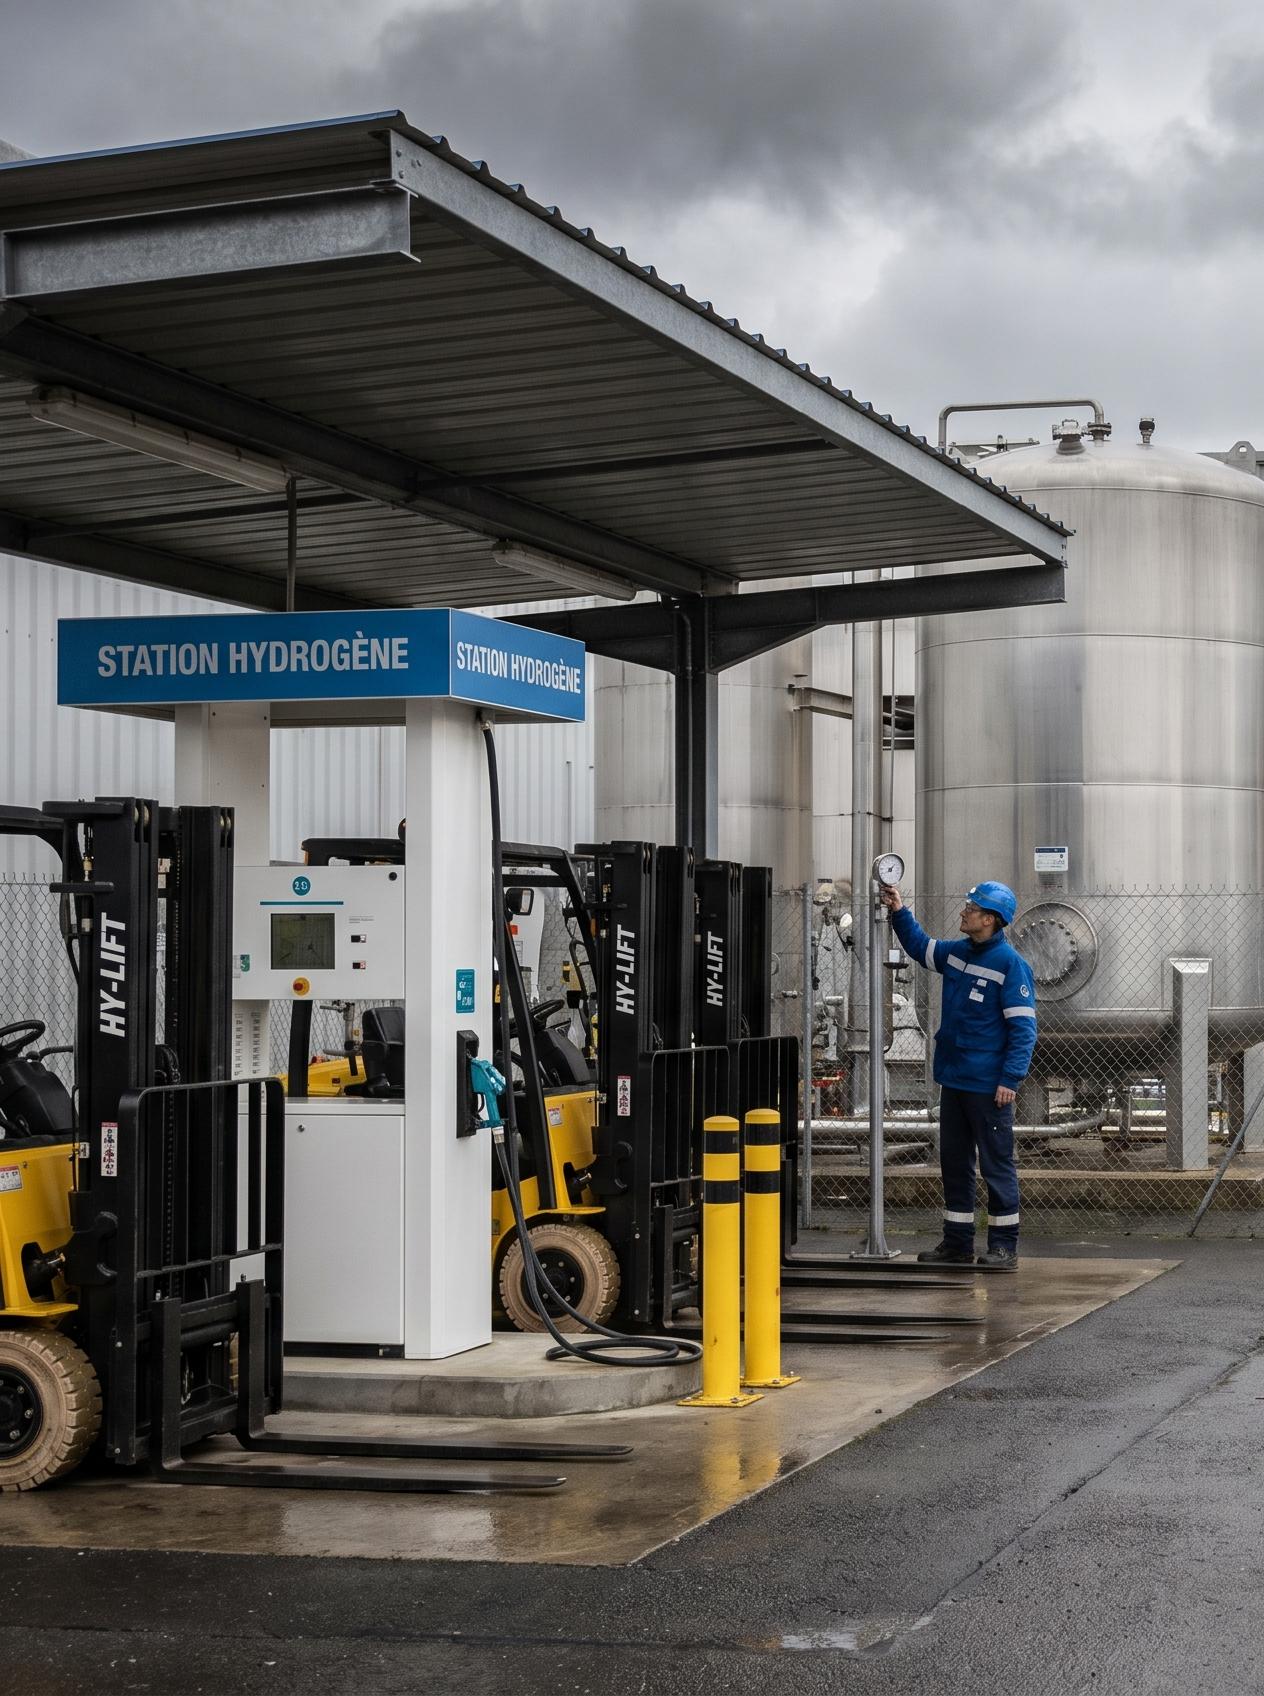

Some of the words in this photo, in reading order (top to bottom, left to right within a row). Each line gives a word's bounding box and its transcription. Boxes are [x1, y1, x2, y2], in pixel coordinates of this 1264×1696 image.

[97, 643, 219, 678] STATION
[229, 631, 409, 675] HYDROGÈNE
[456, 641, 508, 679] STATION
[510, 653, 581, 695] HYDROGÈNE
[99, 911, 126, 1038] HY-LIFT
[615, 924, 635, 1015] HY-LIFT
[706, 931, 724, 1007] HY-LIFT
